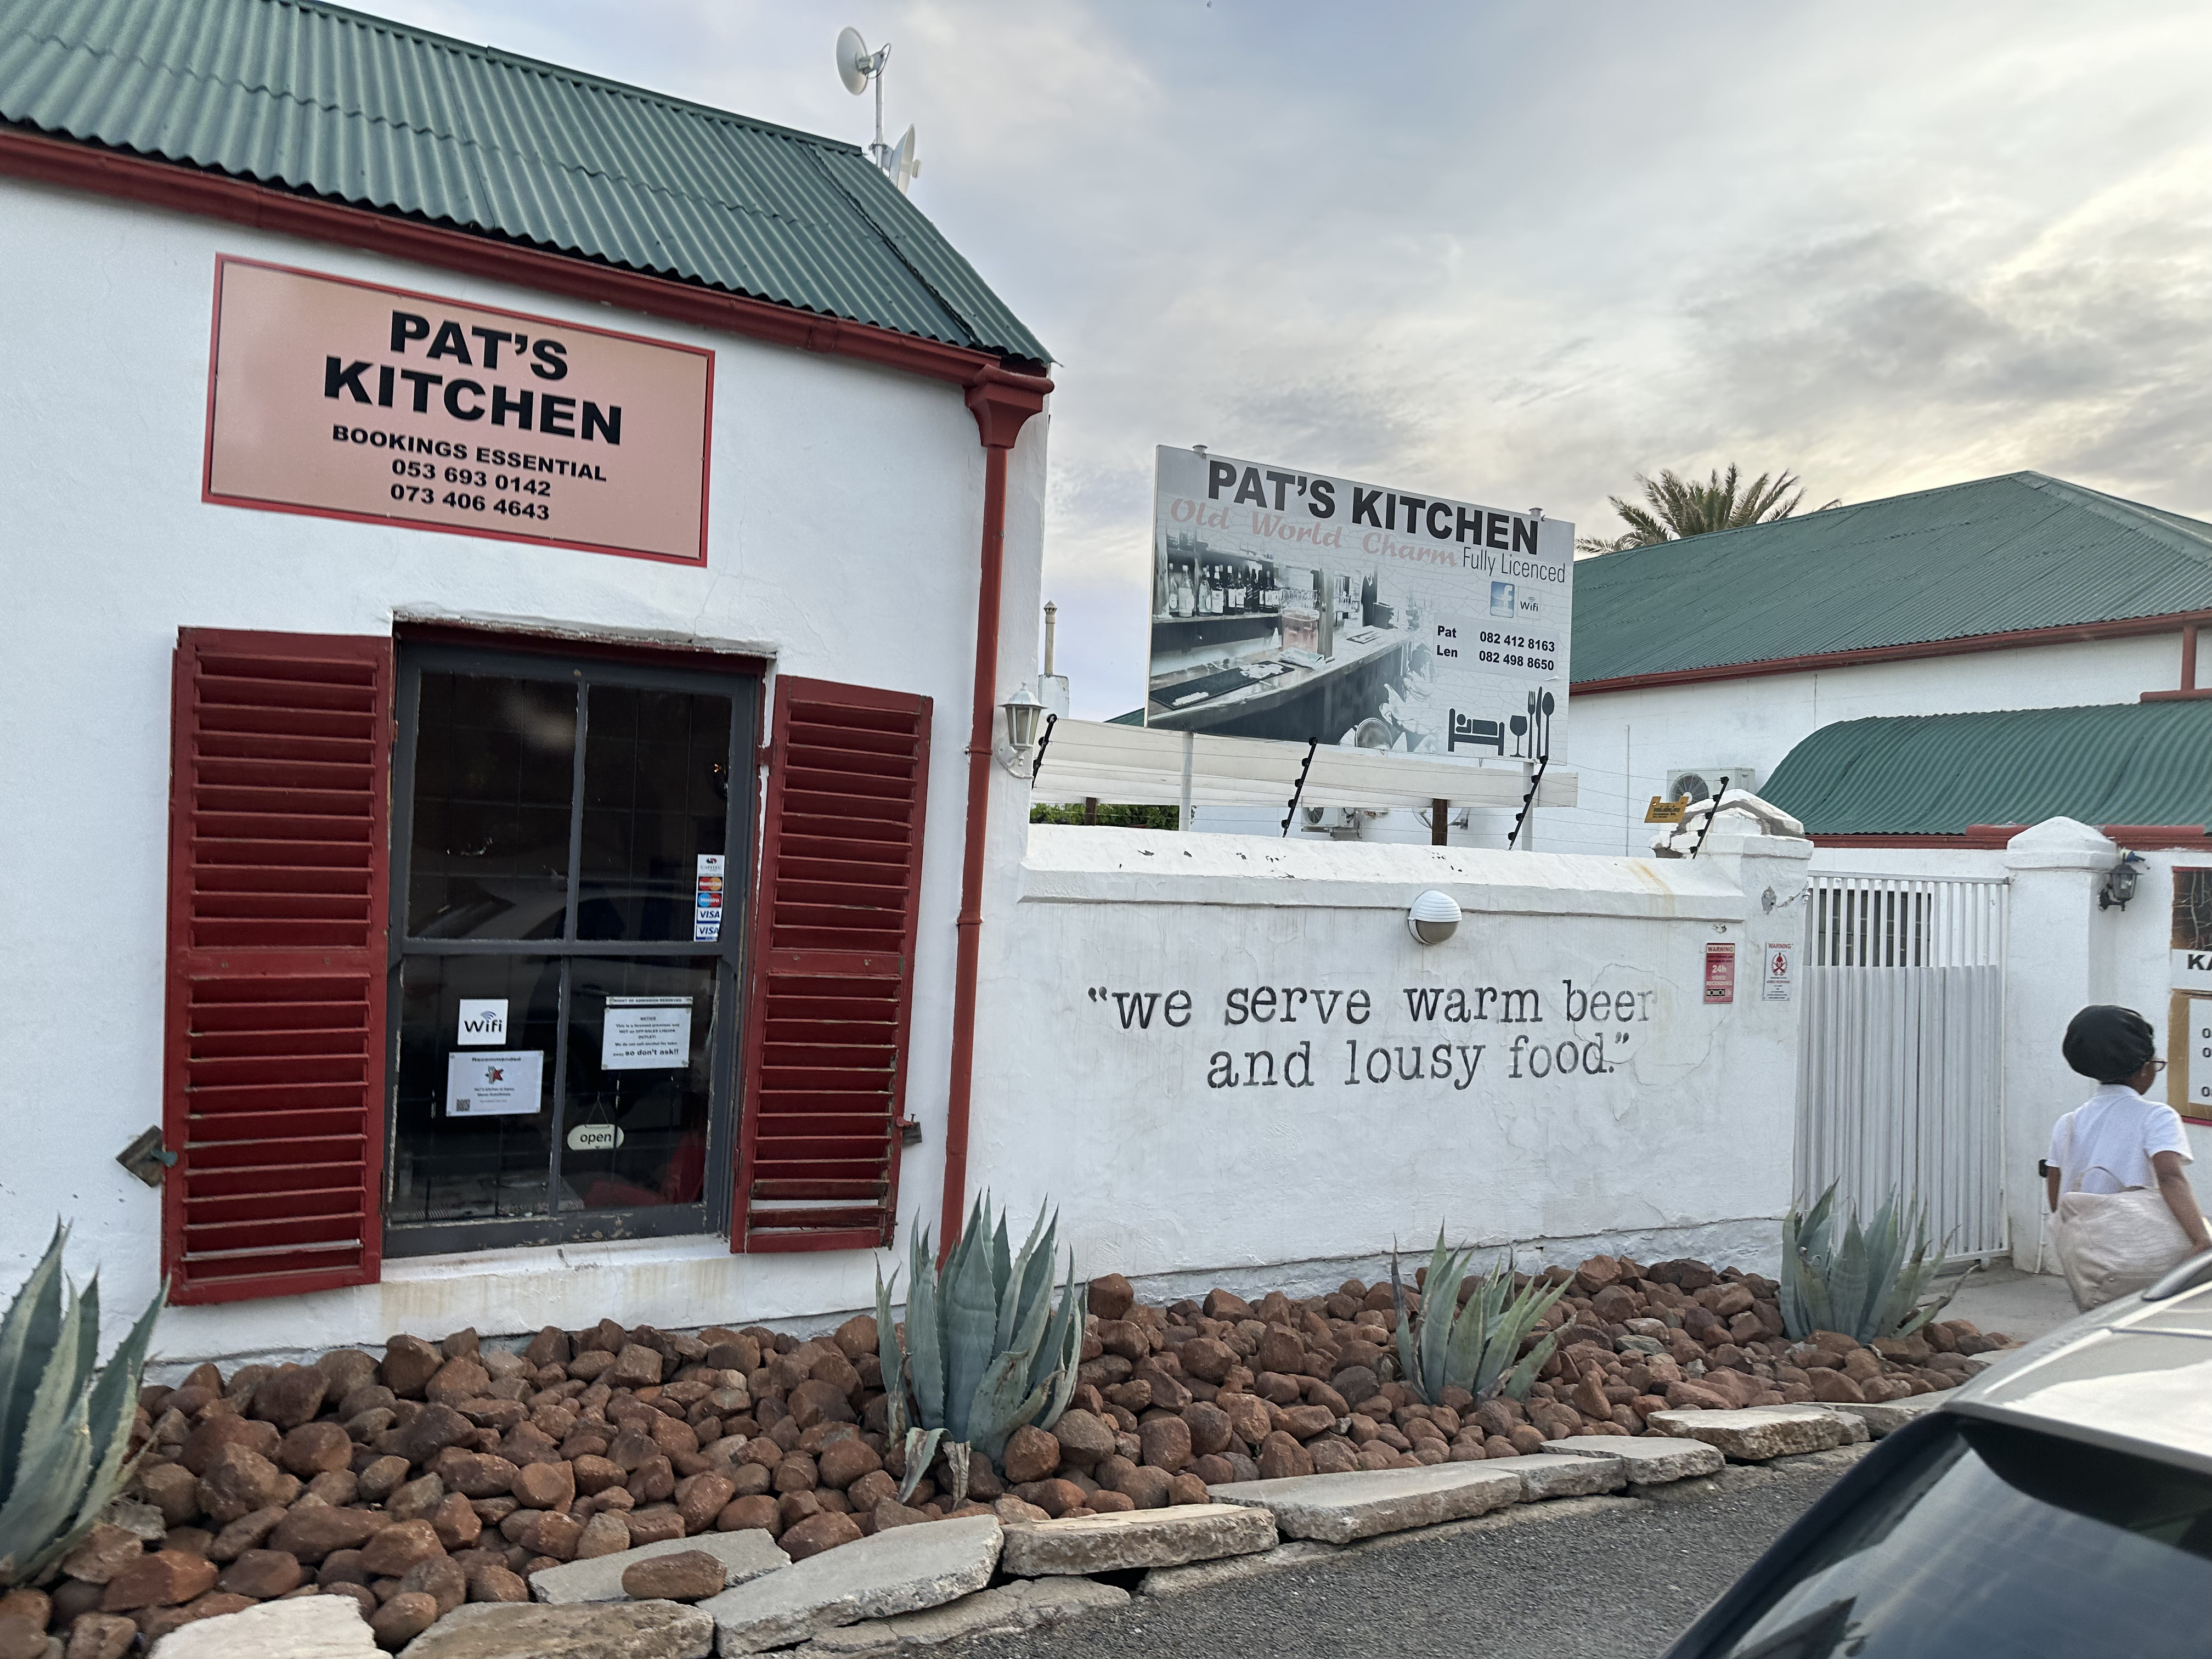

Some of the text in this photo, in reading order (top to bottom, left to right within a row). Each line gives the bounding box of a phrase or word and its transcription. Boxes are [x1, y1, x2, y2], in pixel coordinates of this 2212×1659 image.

[390, 309, 568, 381] PAT'S
[324, 354, 622, 445] KITCHEN
[332, 424, 607, 482] BOOKINGS ESSENTIAL
[392, 459, 551, 497] 053 693 0142
[390, 483, 549, 521] 073 406 4643
[1209, 460, 1538, 555] PAT'S KITCHEN
[1171, 498, 1457, 566] Old World Charm
[1463, 546, 1565, 583] Fully Licenced
[1520, 601, 1538, 612] Wifi
[1437, 625, 1555, 652] Pat 082 412 8163
[1437, 645, 1554, 670] Len 082 498 8650
[1712, 964, 1726, 973] 24h
[1224, 986, 1371, 1025] serve
[1403, 987, 1543, 1023] warm
[1562, 979, 1657, 1023] beer
[464, 1020, 503, 1032] Wifi
[1207, 1040, 1314, 1088] and
[1344, 1040, 1486, 1091] lousy
[580, 1133, 611, 1145] open
